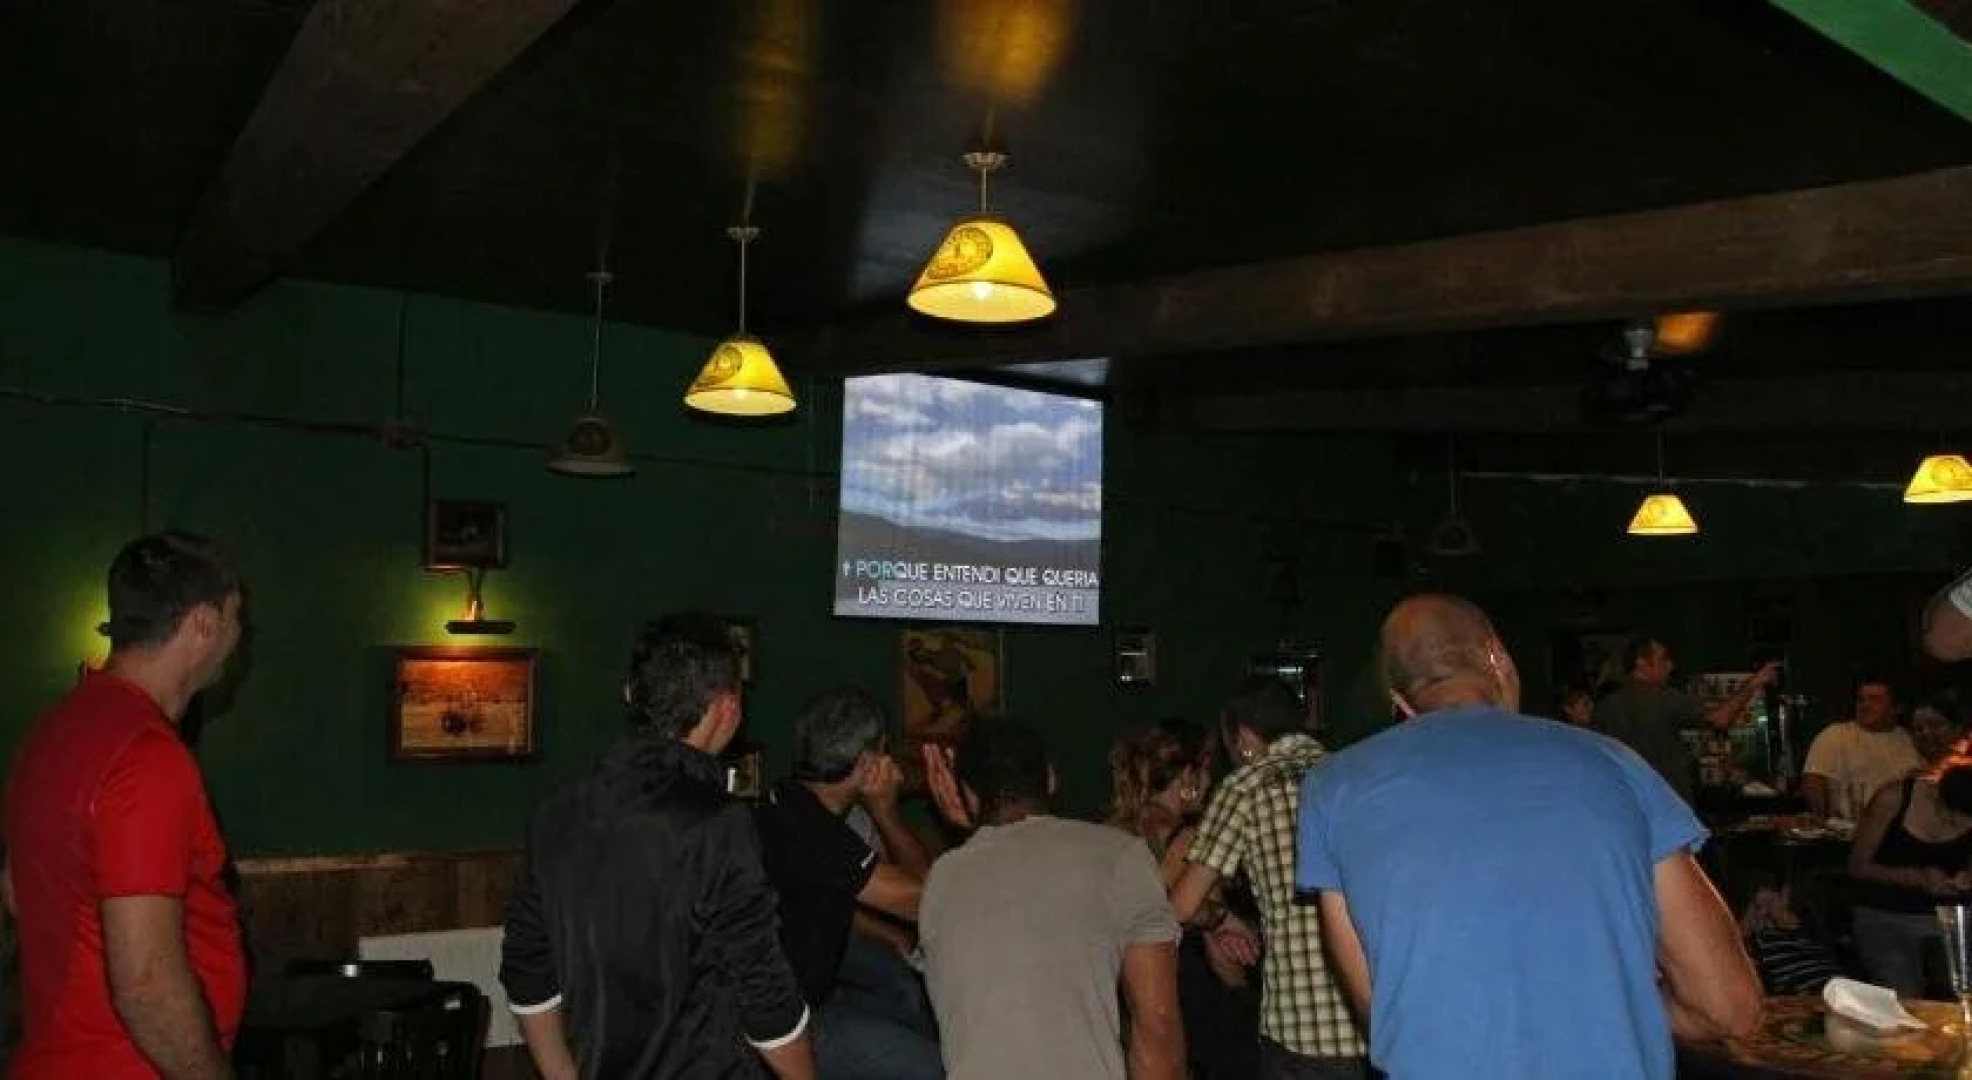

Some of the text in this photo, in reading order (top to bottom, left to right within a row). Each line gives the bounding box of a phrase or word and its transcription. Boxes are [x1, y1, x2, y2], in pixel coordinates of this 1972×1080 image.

[856, 560, 928, 581] PORQUE
[933, 563, 1000, 584] ENTENDI
[1004, 566, 1037, 586] QUE
[858, 586, 888, 605] LAS
[894, 588, 952, 607] COSAS
[957, 590, 994, 609] QUE
[1046, 594, 1067, 612] EN
